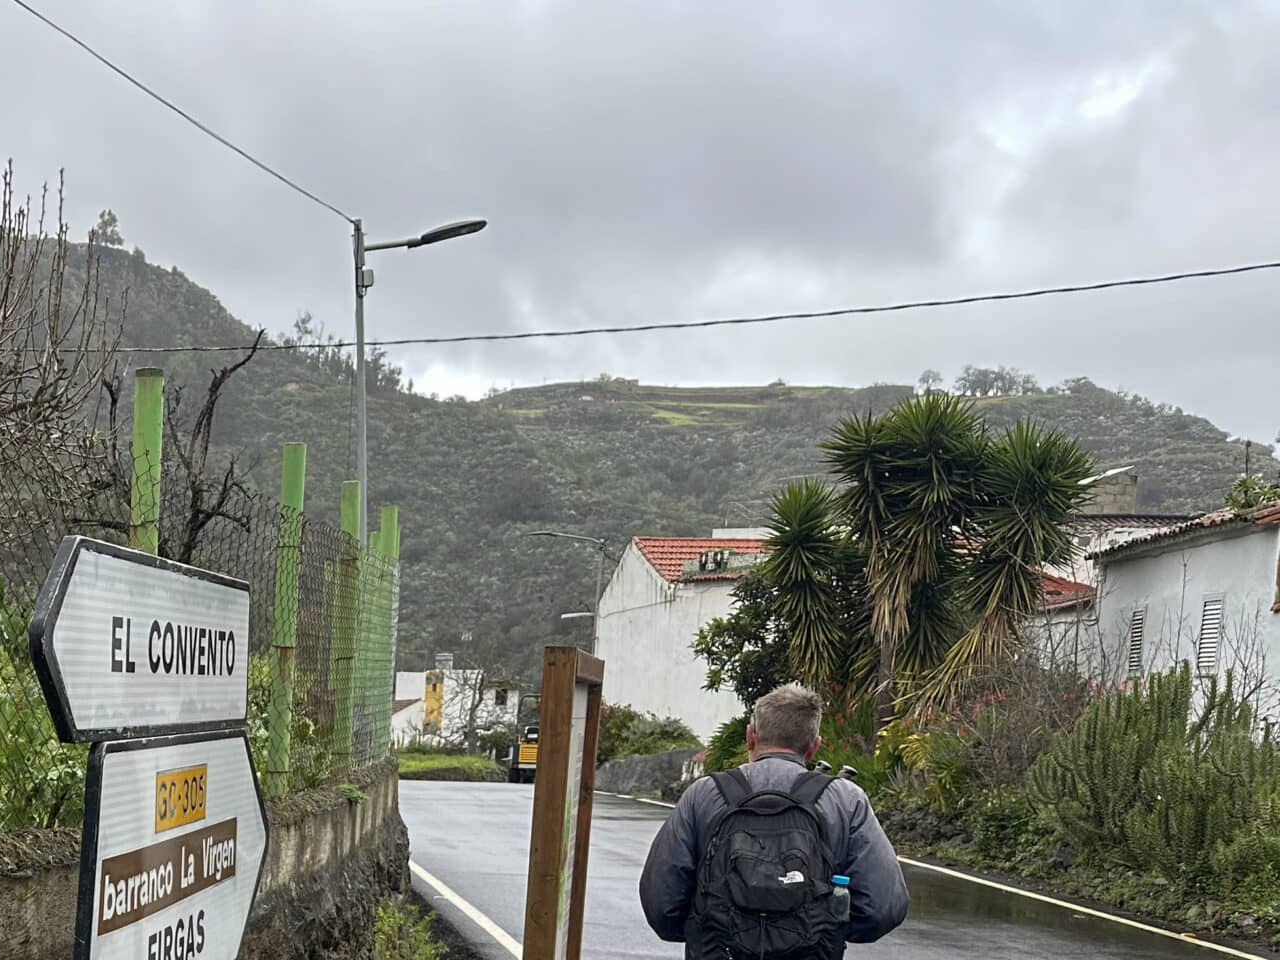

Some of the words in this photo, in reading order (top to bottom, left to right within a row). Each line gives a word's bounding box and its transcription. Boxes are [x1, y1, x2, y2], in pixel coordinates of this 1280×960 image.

[111, 616, 136, 673] EL
[148, 619, 236, 677] CONVENTO
[102, 860, 174, 922] barranco
[180, 845, 195, 889] La
[202, 835, 235, 881] Virgen
